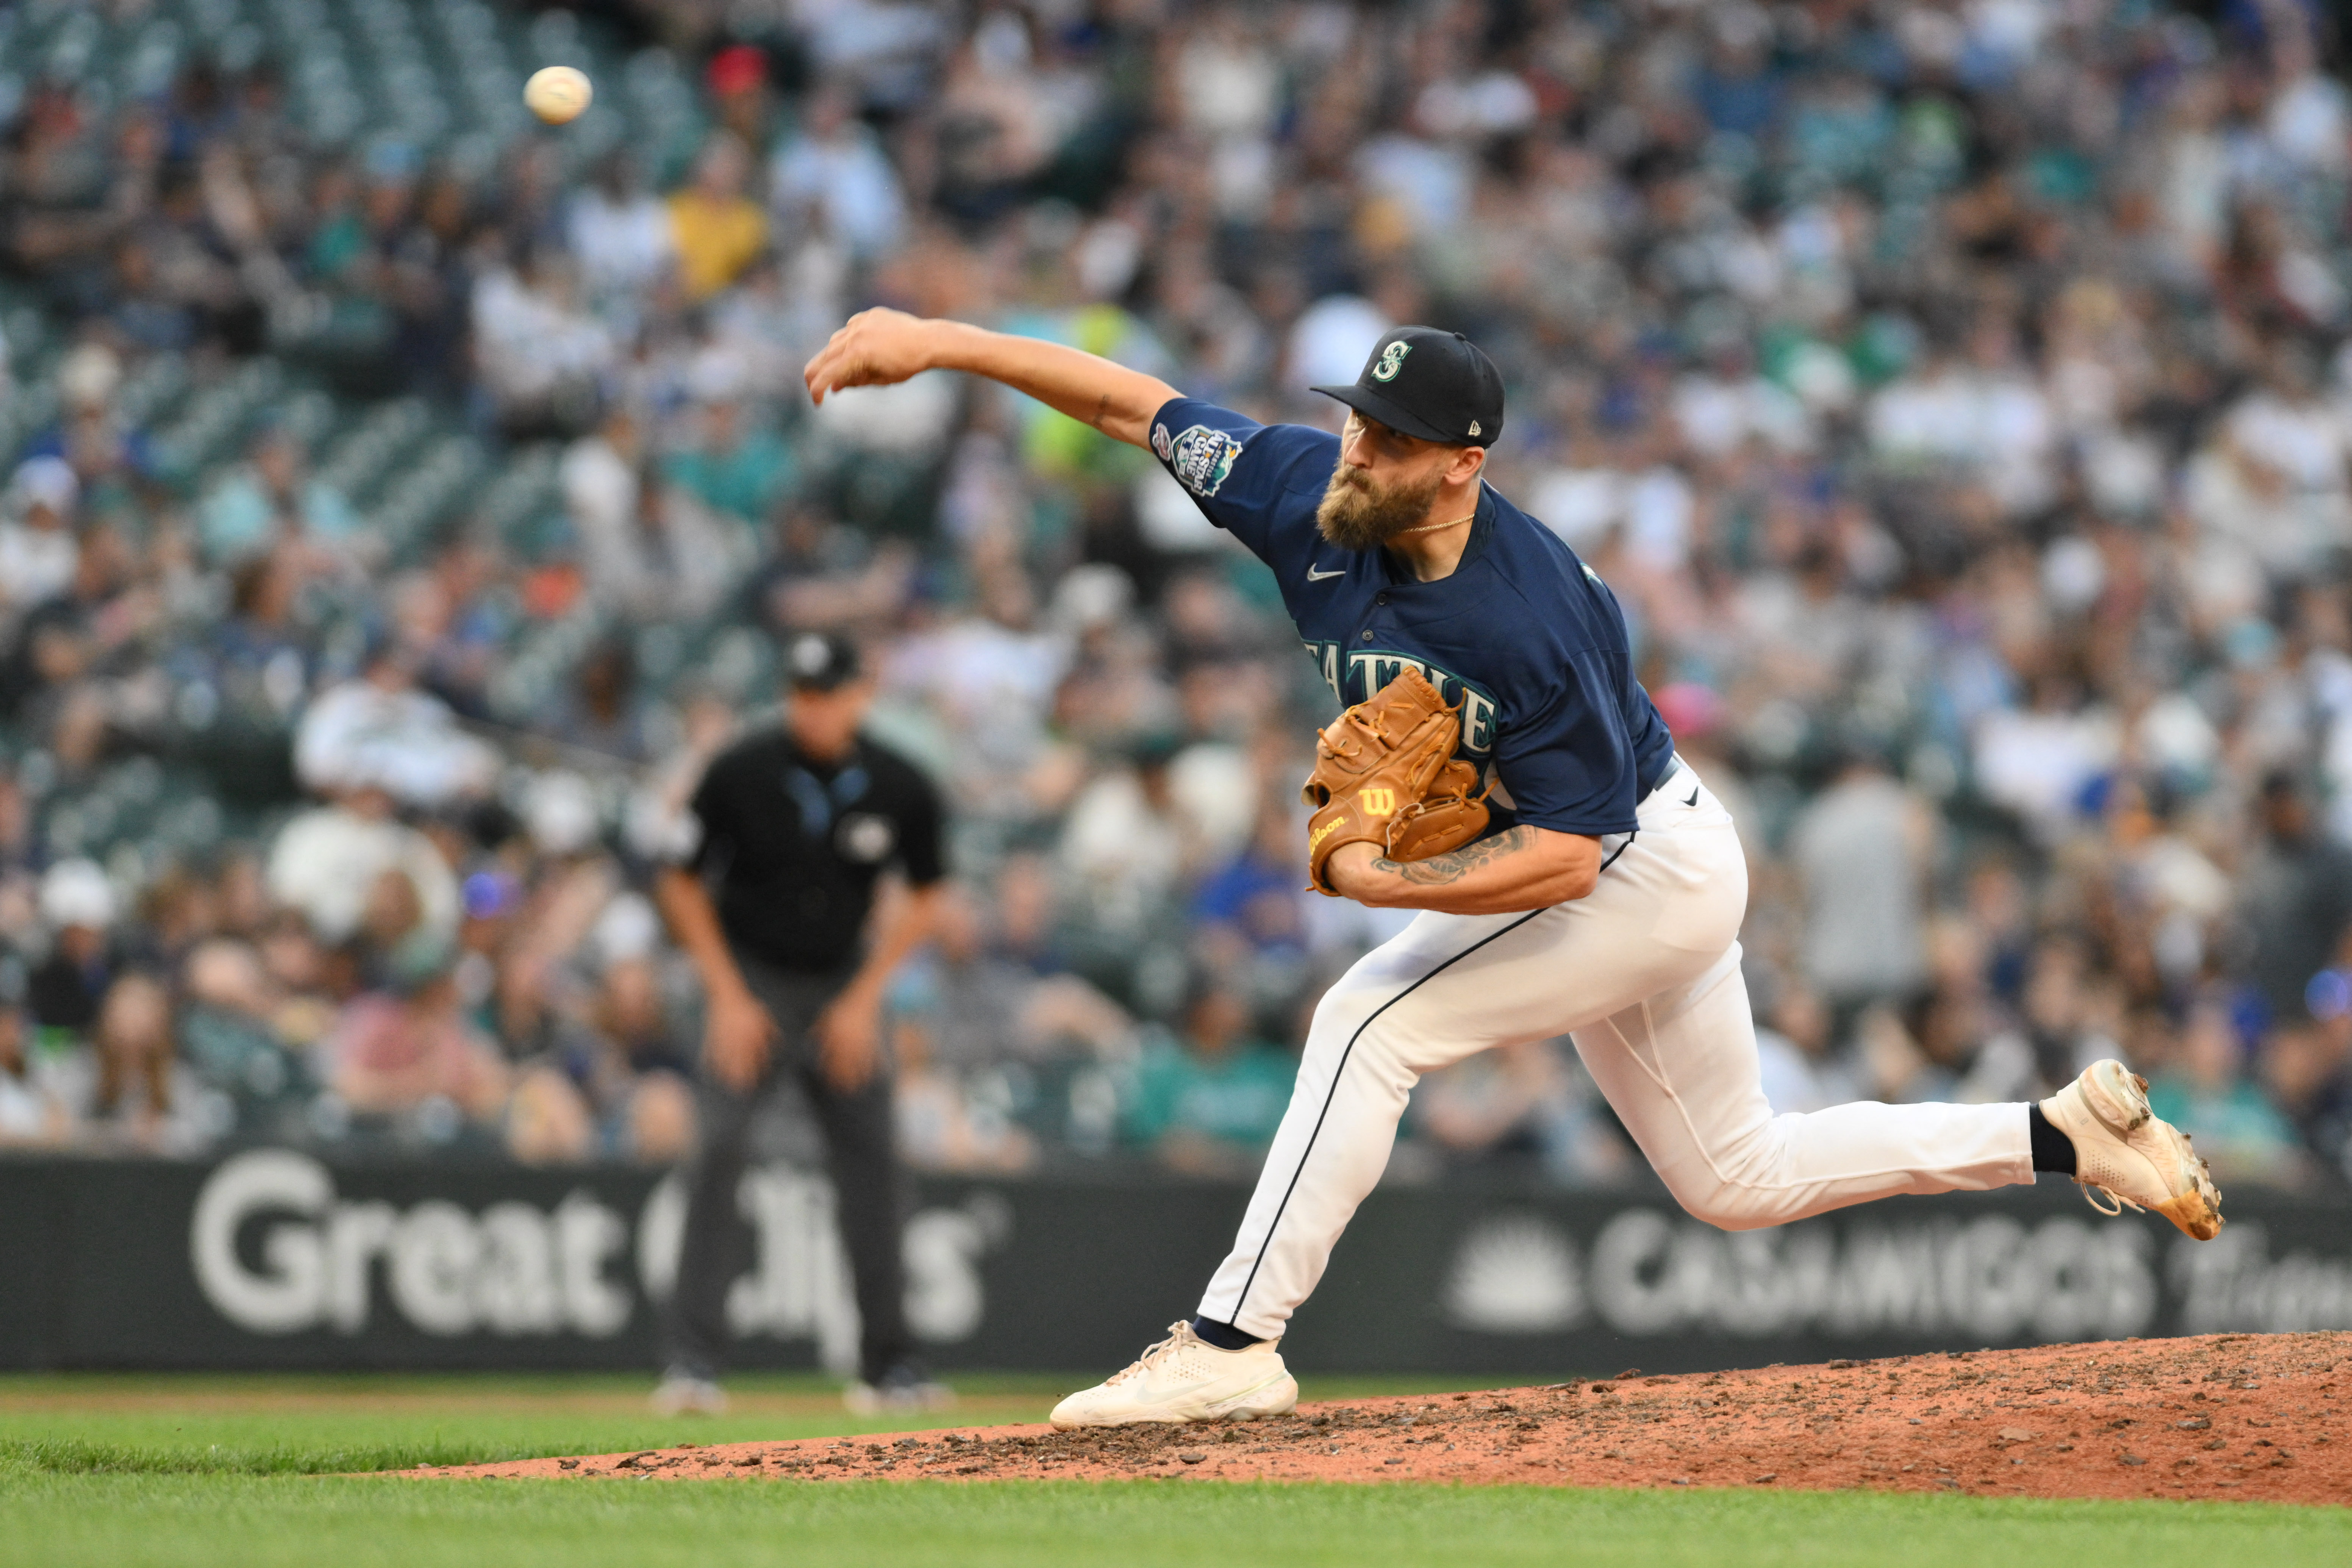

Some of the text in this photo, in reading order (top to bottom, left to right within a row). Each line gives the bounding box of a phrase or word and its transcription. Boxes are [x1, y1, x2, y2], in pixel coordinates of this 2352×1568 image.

[1371, 341, 1413, 382] S
[1186, 436, 1207, 477] GAME
[1358, 788, 1396, 816] W
[192, 1150, 631, 1337] Great
